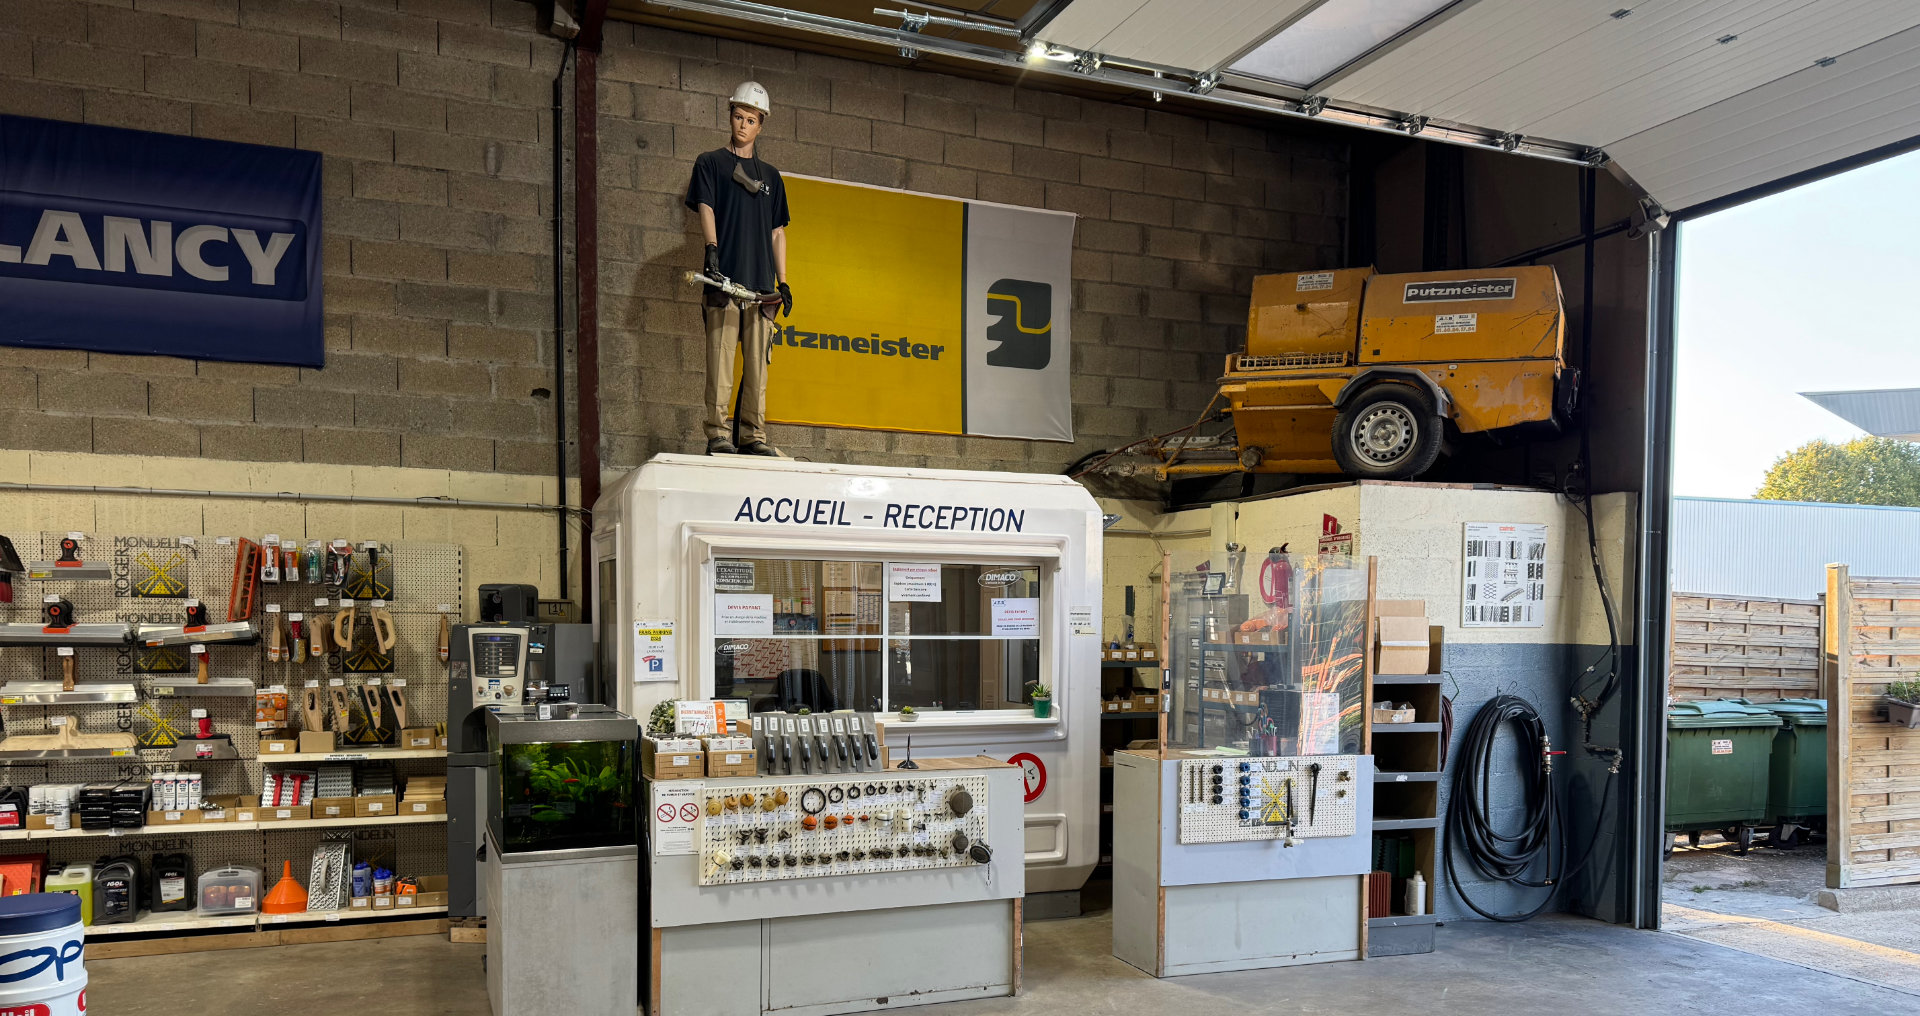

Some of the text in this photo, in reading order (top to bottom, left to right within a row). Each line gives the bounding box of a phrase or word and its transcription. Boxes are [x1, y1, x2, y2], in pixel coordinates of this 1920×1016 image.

[1407, 284, 1512, 297] Putzmeister
[773, 324, 945, 361] tzmeister
[734, 496, 851, 526] ACCUEIL
[883, 503, 1025, 533] RECEPTION
[114, 536, 180, 548] MONDELI
[114, 548, 130, 598] ROGER
[985, 573, 1016, 581] DIMACO
[723, 643, 749, 651] DIMACO
[651, 660, 660, 670] P
[119, 838, 193, 852] MONDELIN
